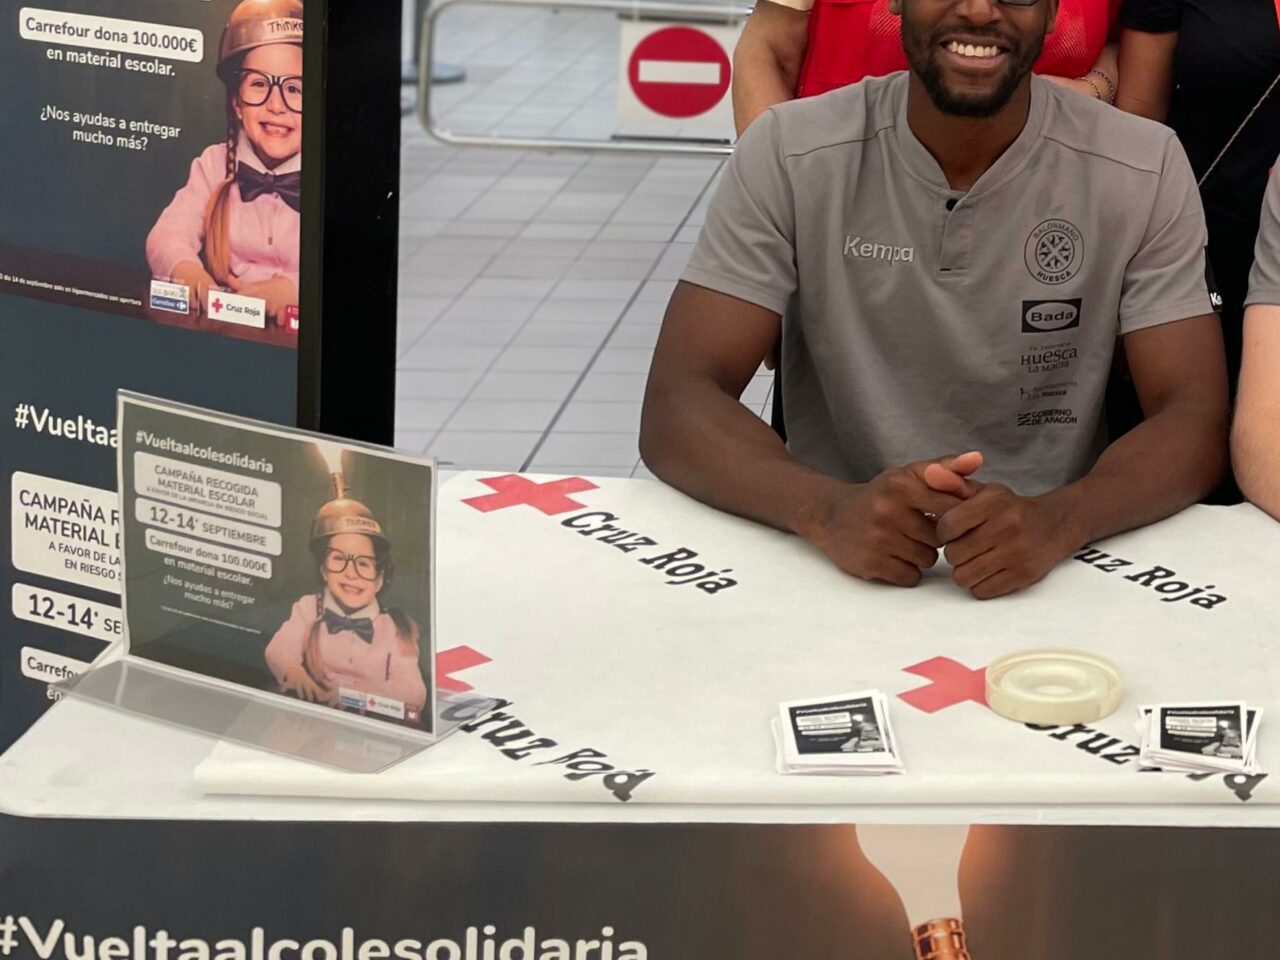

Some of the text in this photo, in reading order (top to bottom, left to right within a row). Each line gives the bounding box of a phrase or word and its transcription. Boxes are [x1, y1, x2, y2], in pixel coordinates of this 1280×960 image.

[25, 16, 198, 53] Carrefour dona 100.000€
[46, 47, 176, 77] en material escolar.
[39, 104, 181, 139] ¿Nos ayudas a entregar
[72, 129, 148, 151] mucho más?
[1032, 221, 1079, 242] BALONMANO
[843, 234, 914, 266] Kempa
[1036, 270, 1072, 282] HUESCA
[226, 303, 261, 317] Cruz Roja
[1030, 310, 1074, 323] Bada
[1020, 347, 1078, 366] Huesca
[1031, 417, 1042, 426] DE
[135, 430, 274, 474] #Vueltaalcolesolidaria
[154, 464, 259, 498] CAMPAÑA RECOGIDA
[157, 478, 256, 509] MATERIAL ESCOLAR
[19, 489, 105, 525] CAMPAÑA
[24, 512, 110, 547] MATERIAL
[202, 522, 267, 547] SEPTIEMBRE
[48, 540, 57, 551] A
[58, 542, 91, 559] FAVOR
[92, 551, 107, 563] DE
[149, 535, 268, 573] Carrefour dona 100.000€
[560, 510, 739, 595] Cruz Roja
[64, 558, 78, 571] EN
[79, 561, 116, 580] RIESGO
[163, 557, 176, 567] en
[177, 559, 215, 577] material
[163, 574, 183, 587] ¿Nos
[183, 579, 213, 595] ayudas
[220, 589, 255, 604] entregar
[184, 591, 234, 610] mucho más?
[1123, 565, 1227, 610] Roja
